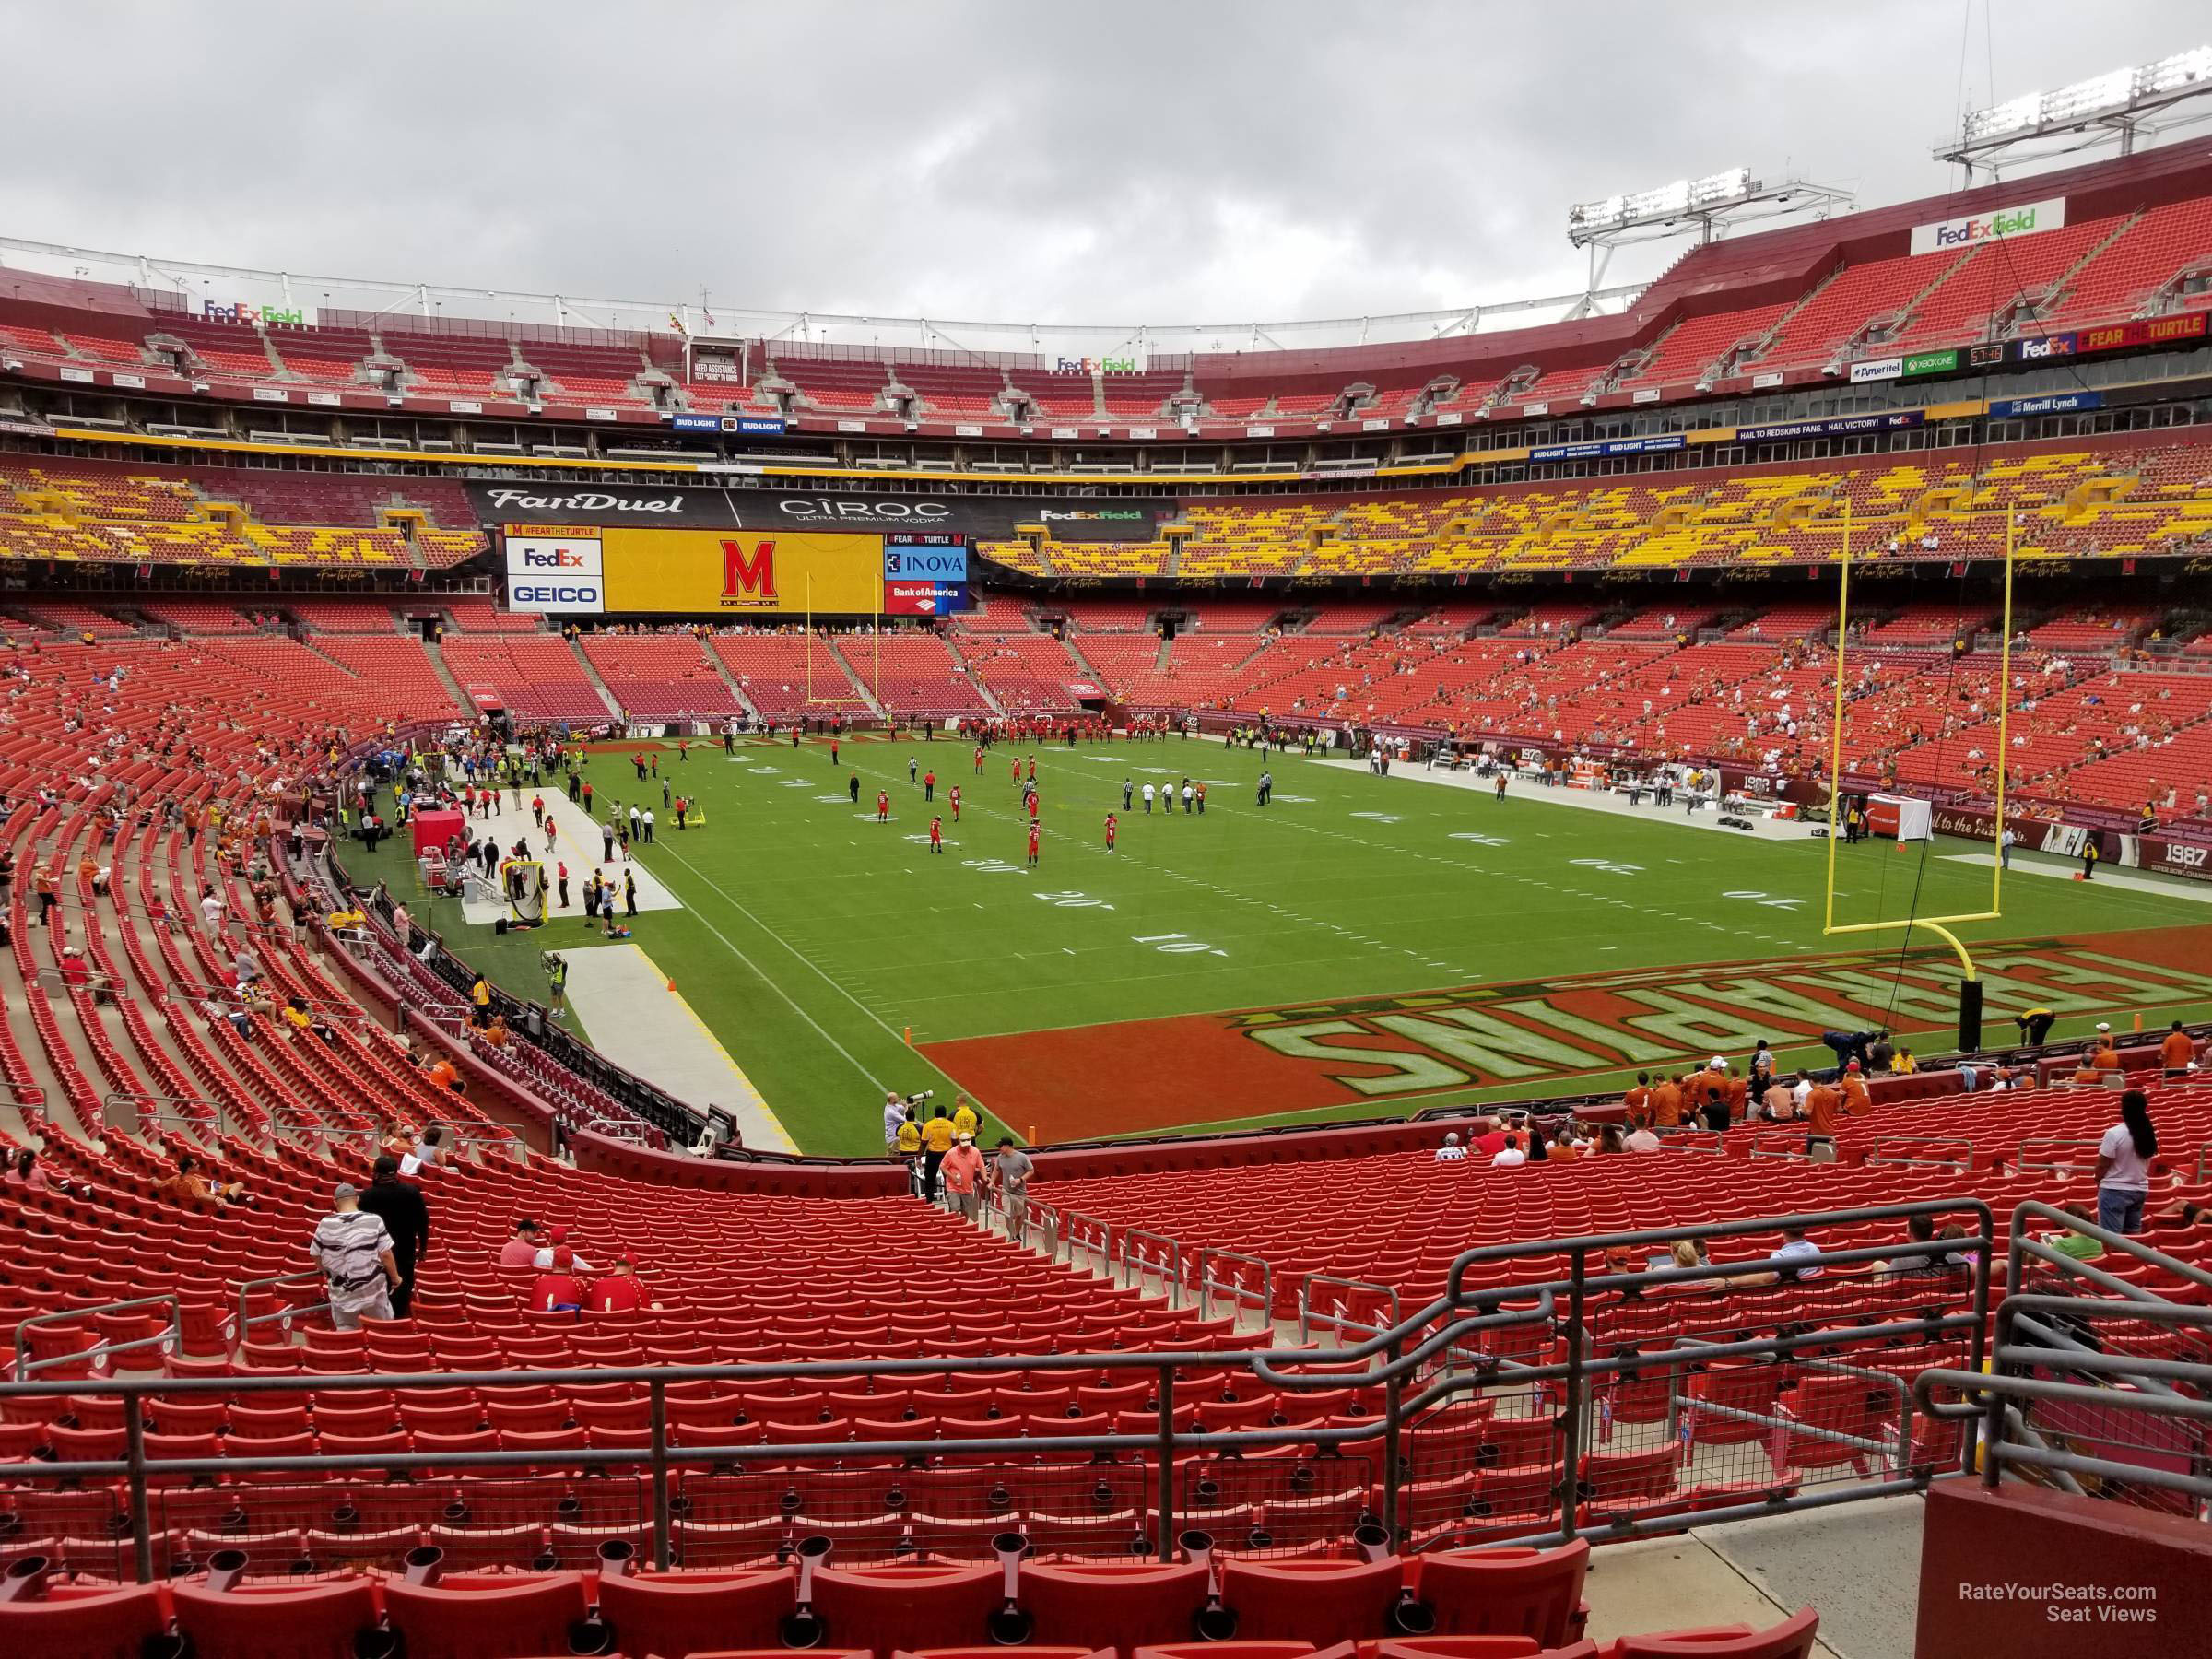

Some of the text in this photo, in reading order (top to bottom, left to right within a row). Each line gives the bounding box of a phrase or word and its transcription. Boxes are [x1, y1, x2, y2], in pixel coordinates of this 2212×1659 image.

[1937, 208, 2035, 246] FedExField
[204, 300, 302, 324] FedExField
[2023, 337, 2069, 359] FedEx
[695, 363, 707, 372] NEED
[1057, 358, 1135, 371] FedExField
[1861, 363, 1900, 377] Ameritel
[1918, 356, 1952, 367] XBOX ONE
[2023, 399, 2051, 412] Merrill
[2052, 397, 2077, 409] Lynch
[1740, 430, 1755, 440] HAIL
[1755, 429, 1765, 439] TO
[1766, 427, 1800, 437] REDSKINS
[1828, 422, 1844, 431] HAIL
[1845, 418, 1879, 429] VICTORY!
[1624, 442, 1641, 451] LIGHT
[487, 489, 683, 512] FanDuel
[780, 499, 950, 516] CÎROC
[1041, 510, 1142, 521] FedExField
[524, 548, 582, 567] FedEx
[907, 557, 963, 571] INOVA
[720, 540, 778, 597] M
[514, 586, 596, 602] GEICO
[894, 588, 958, 597] Bank of America
[1954, 815, 1973, 833] the
[2166, 843, 2208, 866] 1987
[2170, 867, 2187, 877] BOWL
[1033, 890, 1102, 908] 20
[1131, 932, 1212, 954] 10
